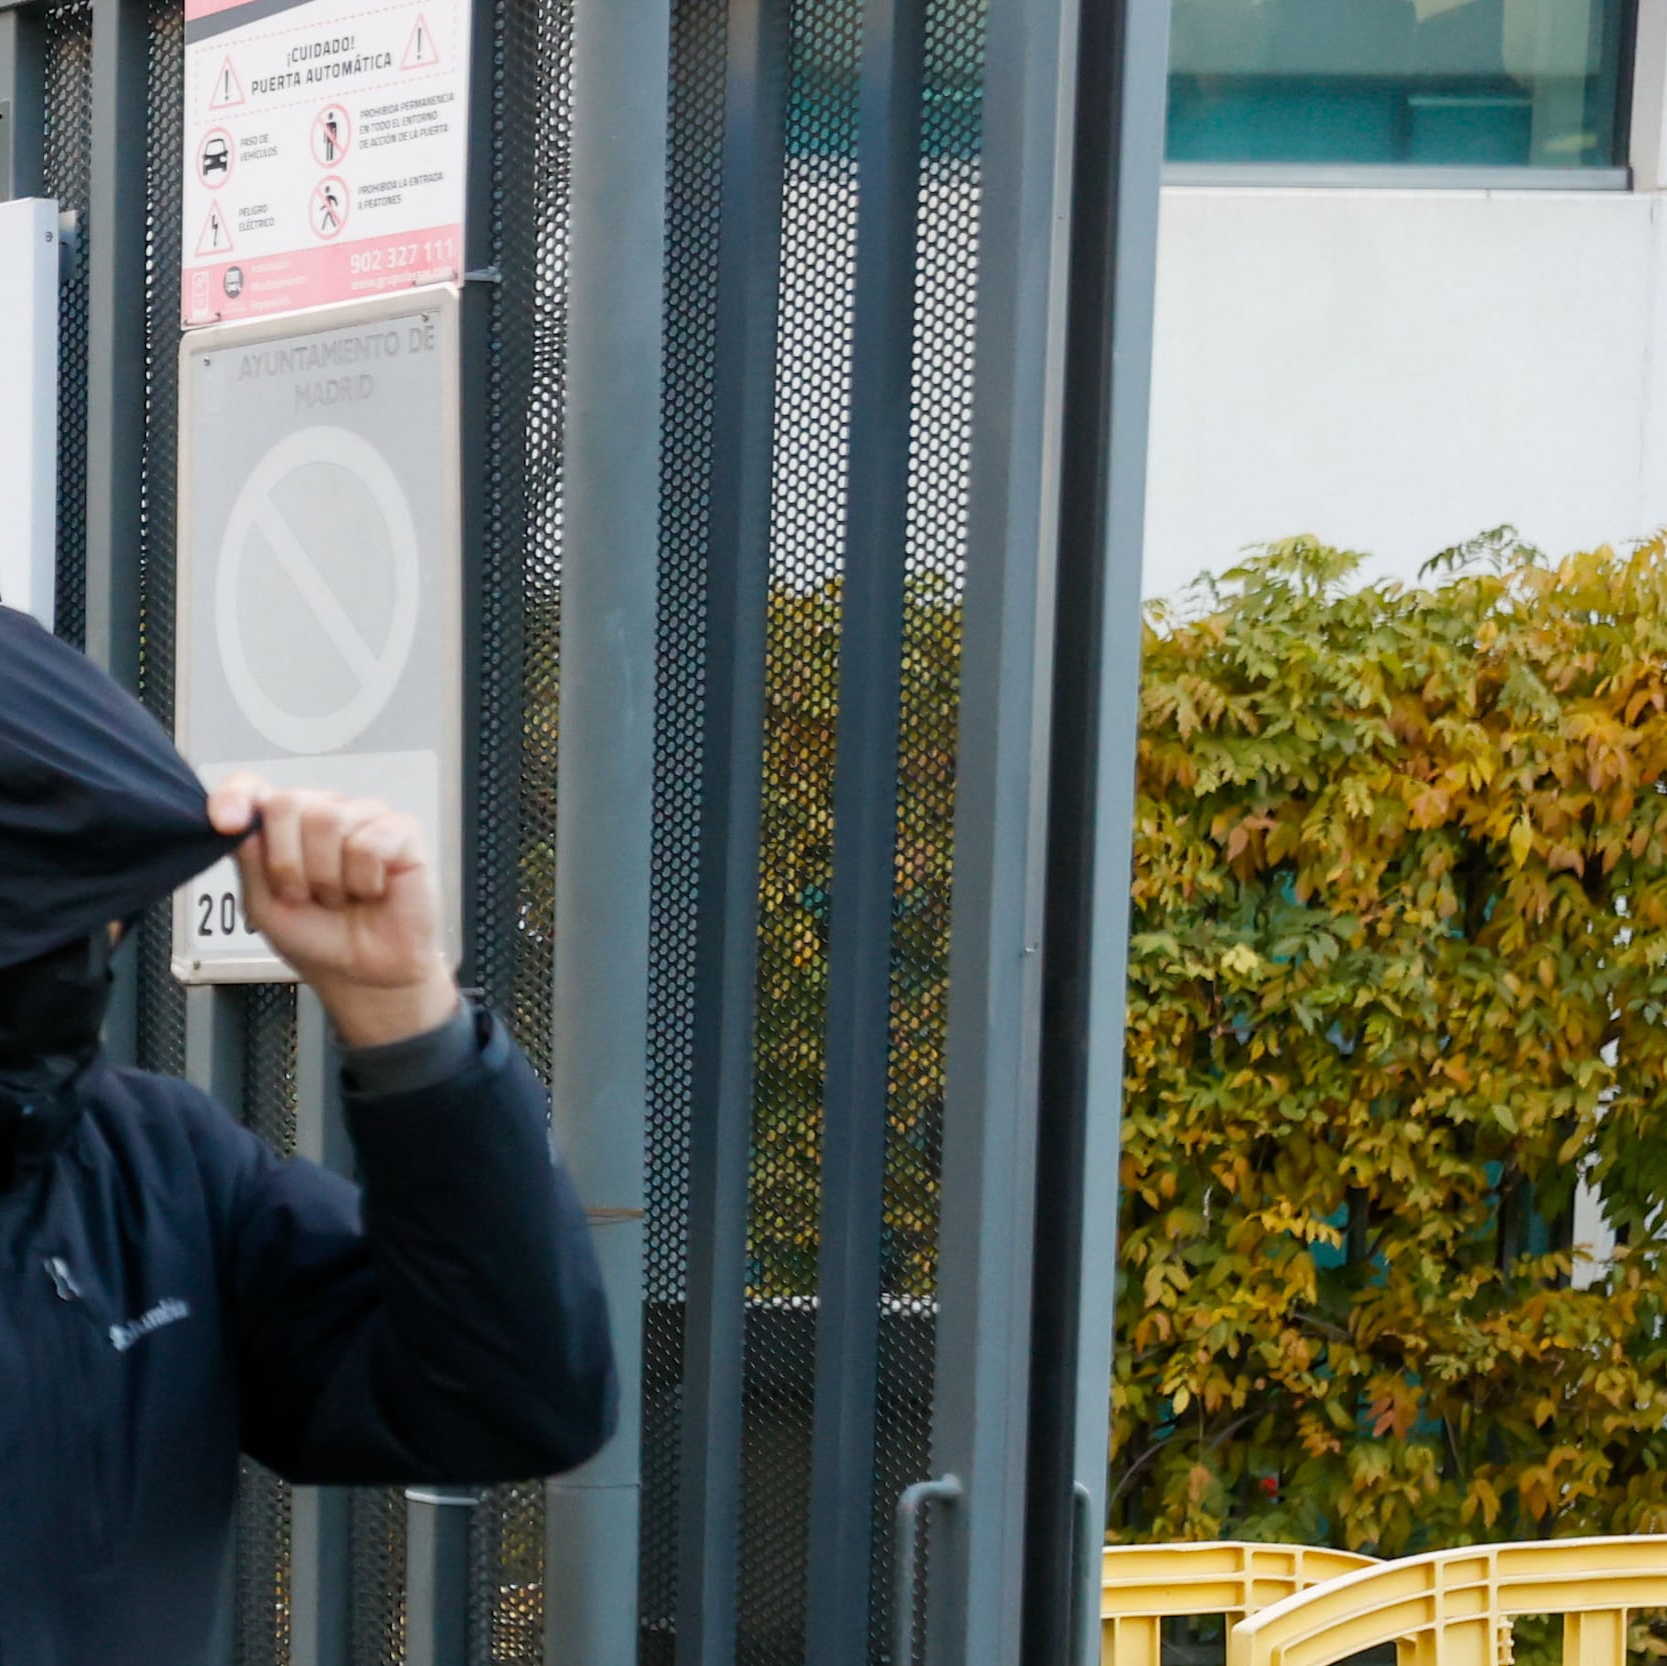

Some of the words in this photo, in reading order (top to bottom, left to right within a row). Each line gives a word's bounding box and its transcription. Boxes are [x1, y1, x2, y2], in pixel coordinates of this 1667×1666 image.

[286, 34, 356, 67] ¡CUIDADO!
[251, 72, 301, 96] PUERTA
[306, 51, 392, 83] AUTOMÁTICA
[359, 103, 399, 119] PROHIBIDA
[400, 92, 455, 112] PERMANENCIA
[359, 123, 370, 135] EN
[371, 119, 390, 133] TODO
[392, 117, 401, 128] EL
[402, 110, 438, 127] ENTORNO
[240, 136, 258, 147] PASO
[259, 133, 269, 144] DE
[359, 138, 369, 149] DE
[369, 131, 397, 147] ACCIÓN
[398, 131, 408, 143] DE
[409, 129, 418, 140] LA
[419, 123, 449, 139] PUERTA
[358, 181, 398, 196] PROHIBIDA
[399, 179, 408, 190] LA
[409, 171, 444, 187] ENTRADA
[238, 204, 268, 217] PELIGRO
[364, 194, 402, 209] PEATONES
[238, 217, 275, 232] ELÉCTRICO
[350, 249, 382, 274] 902
[386, 243, 418, 269] 327
[424, 238, 453, 262] 111
[238, 330, 399, 381] AYUNTAMIENTO
[408, 324, 436, 355] DE
[294, 373, 374, 411] MADRID
